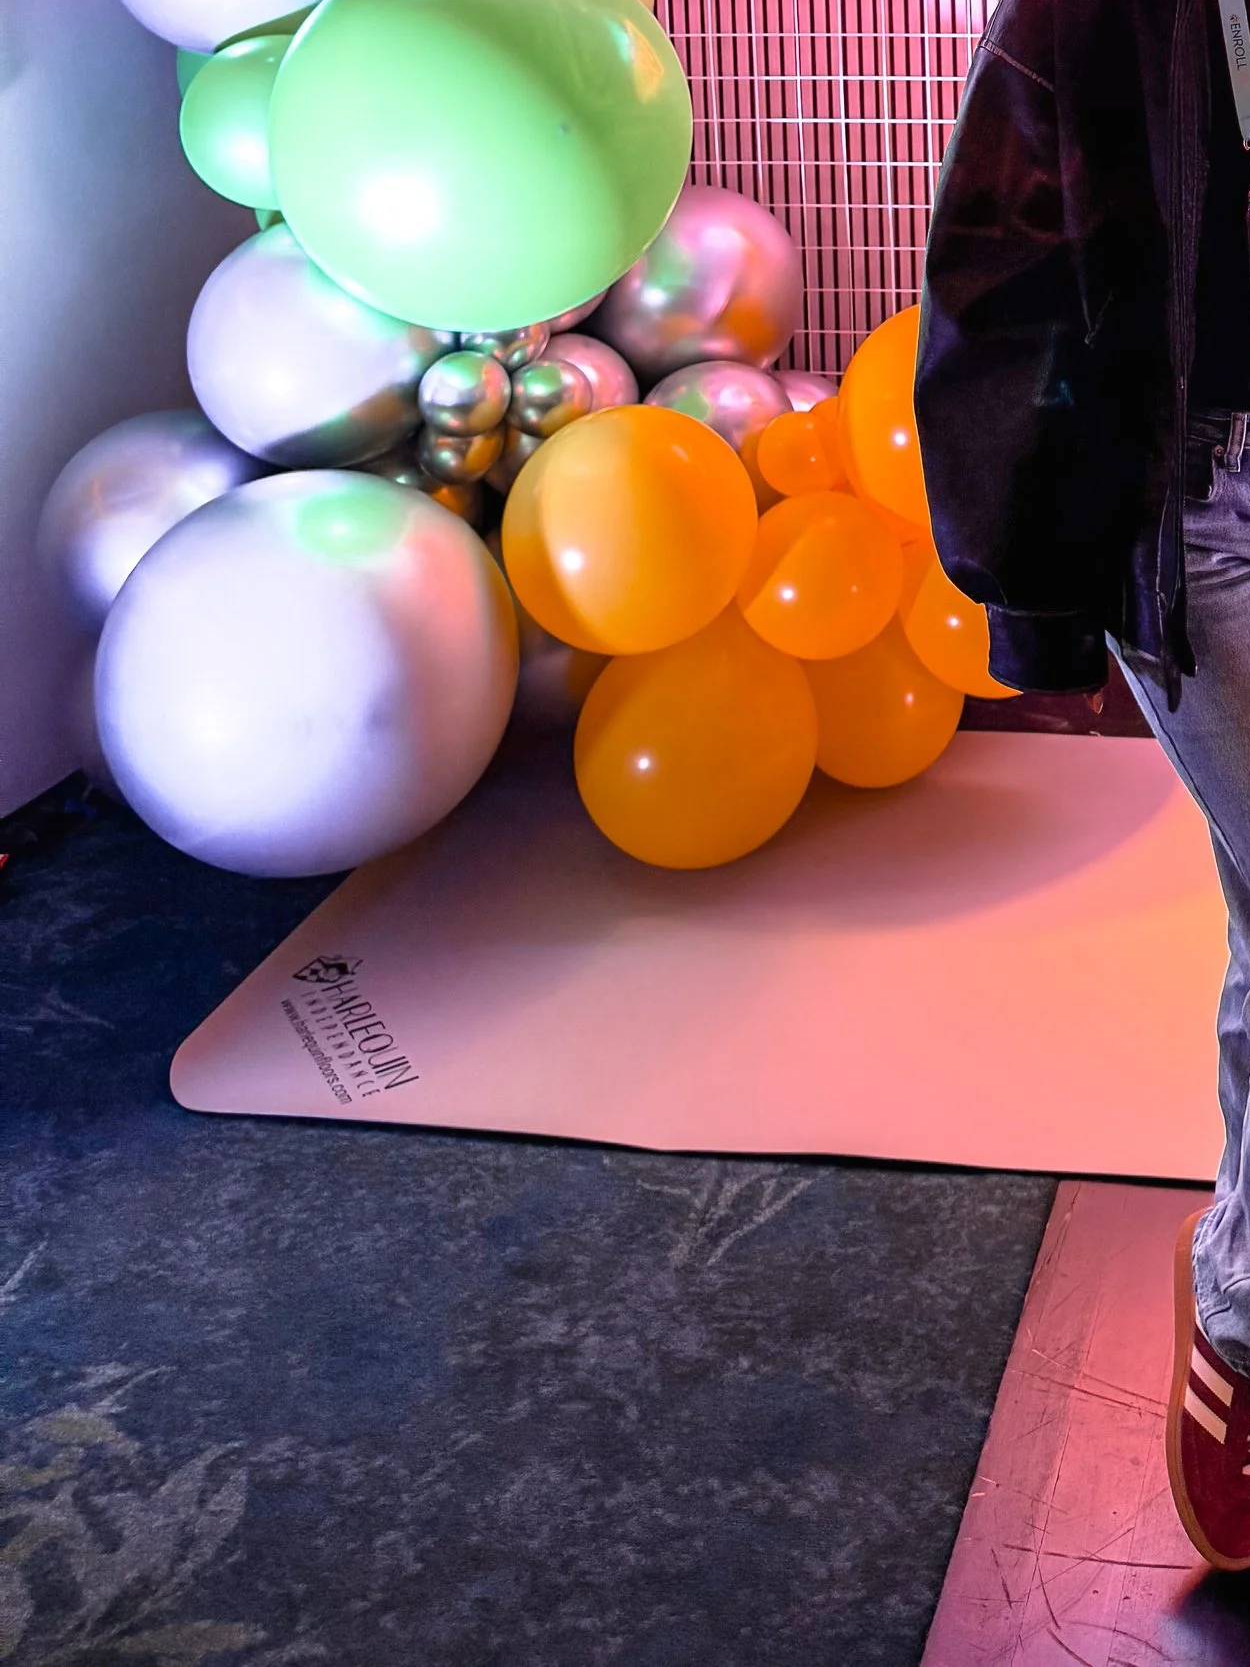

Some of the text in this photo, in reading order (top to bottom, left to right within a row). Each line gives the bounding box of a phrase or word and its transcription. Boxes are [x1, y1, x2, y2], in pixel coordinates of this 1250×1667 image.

[1230, 22, 1247, 71] ENROLL
[280, 998, 353, 1105] www.harlequinfloors.com
[320, 980, 420, 1090] HARLEQUIN
